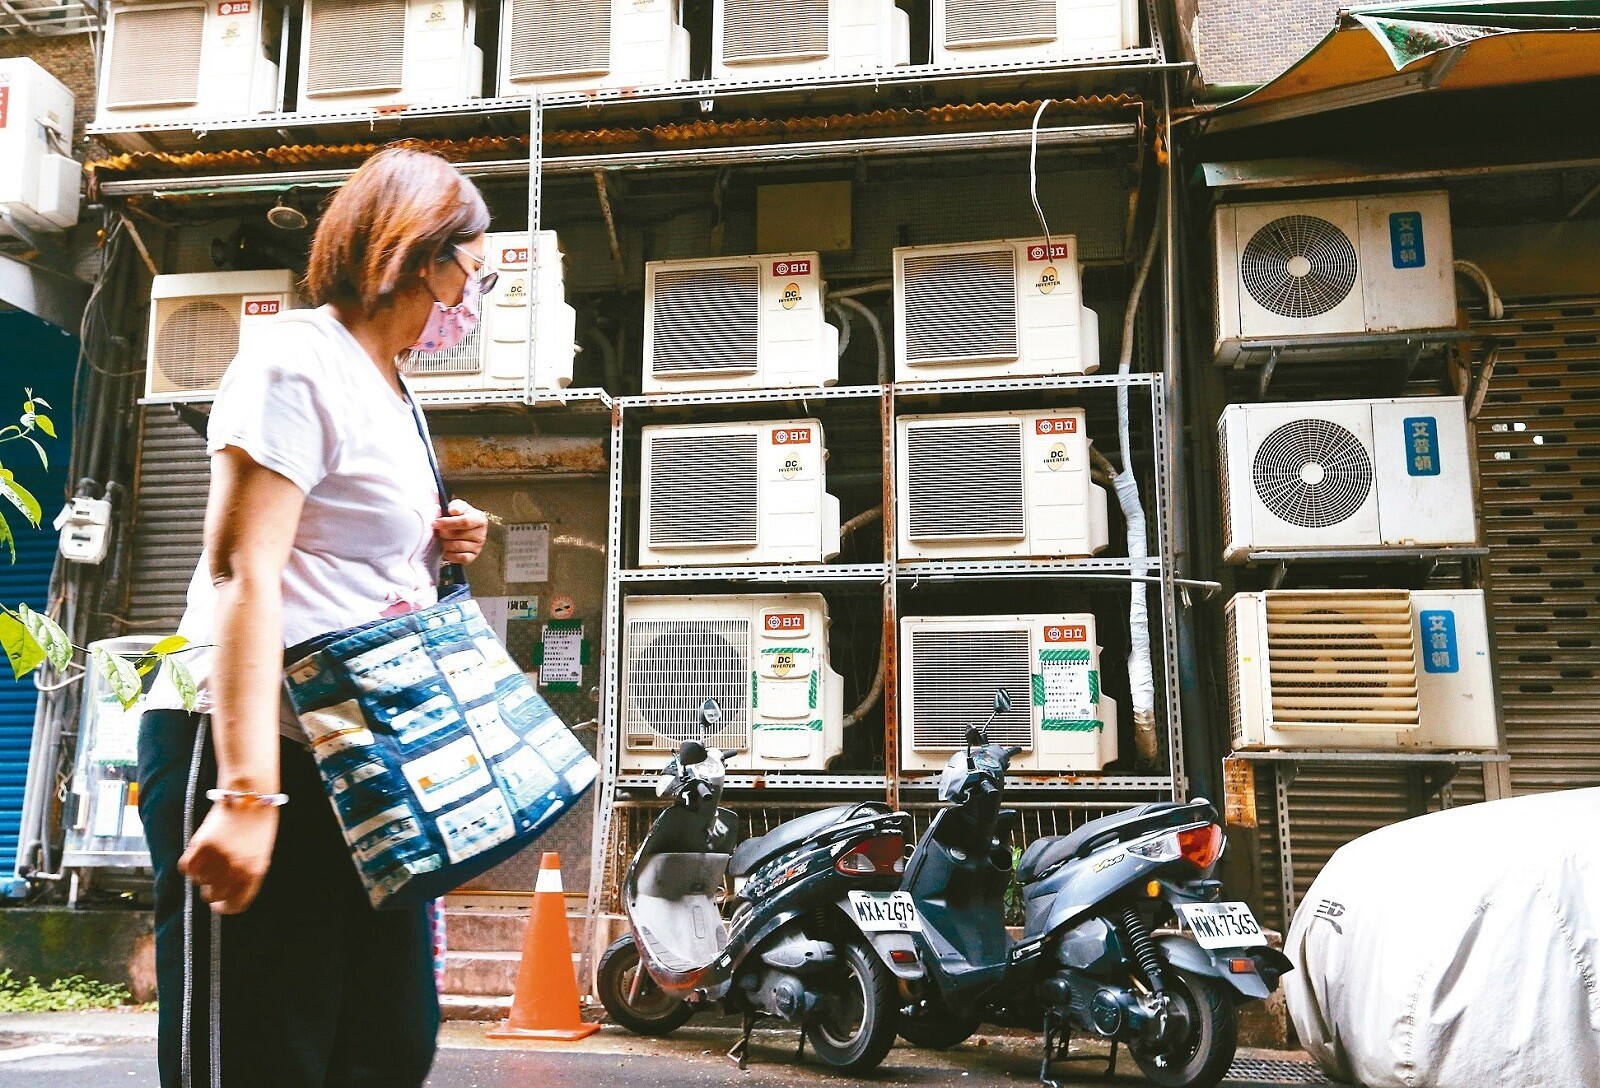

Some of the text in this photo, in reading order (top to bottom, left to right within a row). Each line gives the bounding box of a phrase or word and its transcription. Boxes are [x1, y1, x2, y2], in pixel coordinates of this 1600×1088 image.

[790, 263, 808, 273] 日立
[1042, 274, 1055, 283] DC
[785, 290, 797, 298] DC
[1054, 421, 1074, 431] 日立
[790, 431, 809, 441] 日立
[1050, 450, 1064, 459] DC
[785, 460, 798, 468] DC
[507, 600, 529, 610] 貨區
[783, 616, 801, 627] 日立
[1063, 628, 1083, 639] 日立
[777, 656, 791, 664] DC
